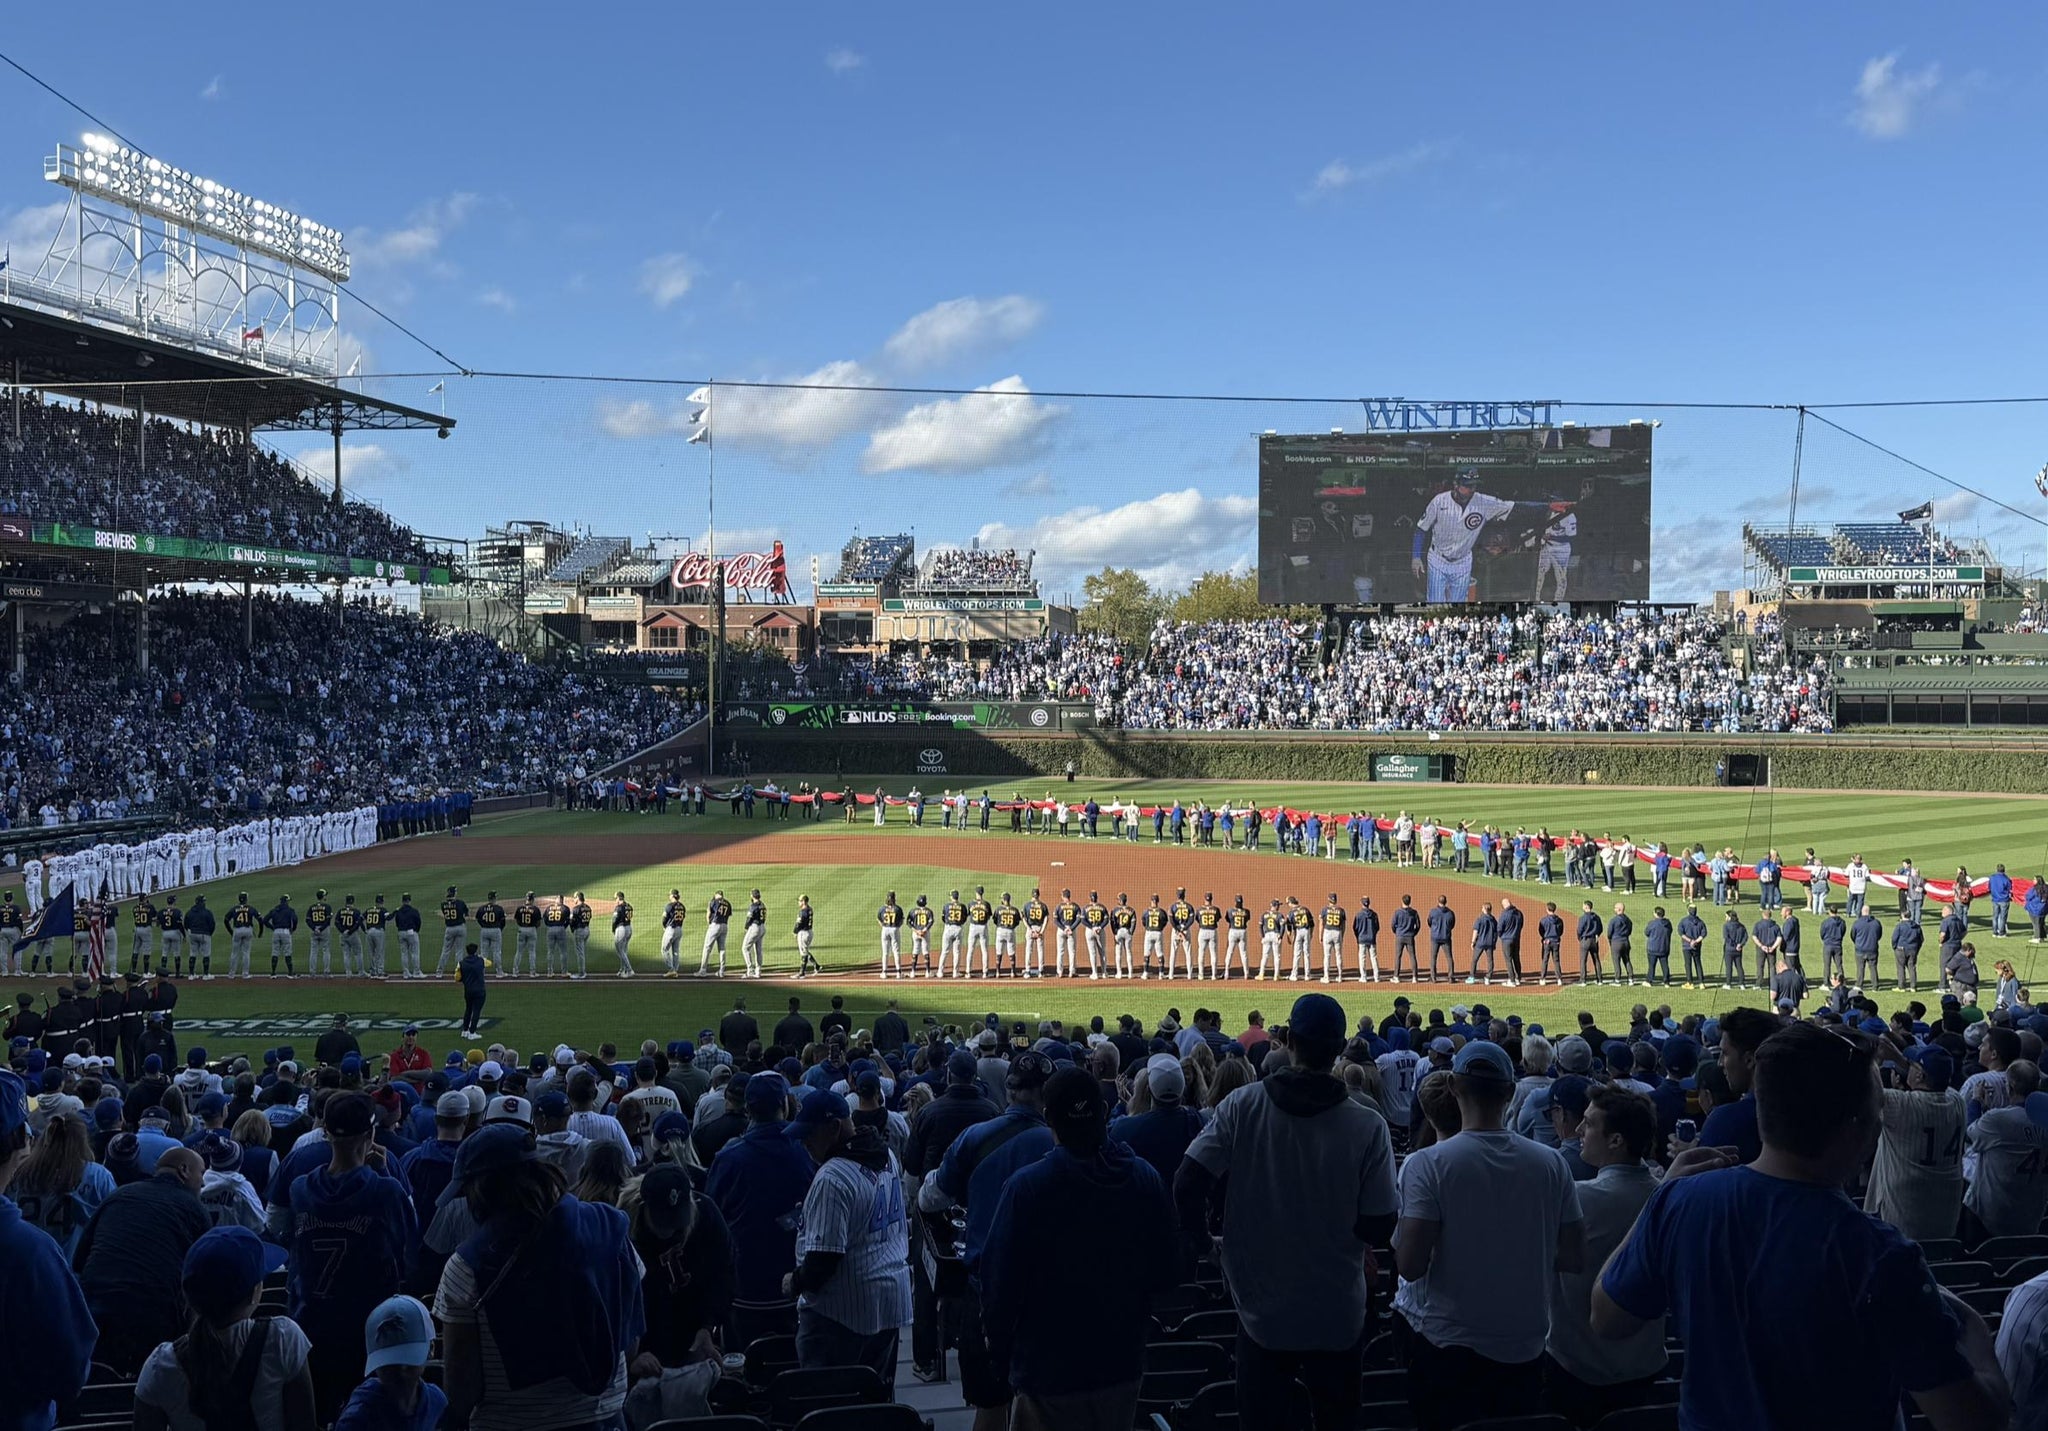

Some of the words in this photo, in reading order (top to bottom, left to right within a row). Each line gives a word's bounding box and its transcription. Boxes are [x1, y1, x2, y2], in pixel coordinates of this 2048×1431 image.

[1285, 455, 1332, 463] Booking.com
[95, 531, 136, 549] BREWERS
[244, 552, 267, 562] NLDS
[285, 555, 317, 565] Booking.com
[389, 565, 405, 578] CUBS
[8, 587, 24, 595] eero
[26, 587, 41, 596] club
[862, 711, 897, 723] NLDS
[925, 712, 976, 721] Booking.com
[1376, 764, 1419, 773] Gallagher
[312, 911, 325, 922] 85
[444, 909, 457, 920] 29
[718, 905, 728, 917] 47
[948, 909, 962, 921] 33
[972, 910, 985, 921] 32
[1029, 908, 1043, 919] 59
[1063, 910, 1073, 920] 12
[1175, 908, 1189, 920] 45
[135, 912, 147, 923] 20
[165, 915, 171, 926] 3
[237, 912, 248, 924] 41
[341, 915, 353, 926] 70
[482, 912, 496, 923] 40
[884, 913, 896, 924] 37
[917, 914, 927, 926] 18
[1088, 911, 1101, 923] 58
[1119, 915, 1129, 925] 14
[1149, 917, 1159, 927] 15
[1201, 915, 1215, 926] 62
[1234, 917, 1245, 927] 51
[1295, 914, 1308, 926] 54
[1326, 914, 1340, 925] 55
[1267, 918, 1275, 929] 6
[173, 1019, 490, 1029] OSTSEASON
[1919, 1126, 1961, 1166] 14
[869, 1176, 901, 1242] 44
[312, 1238, 347, 1296] 7
